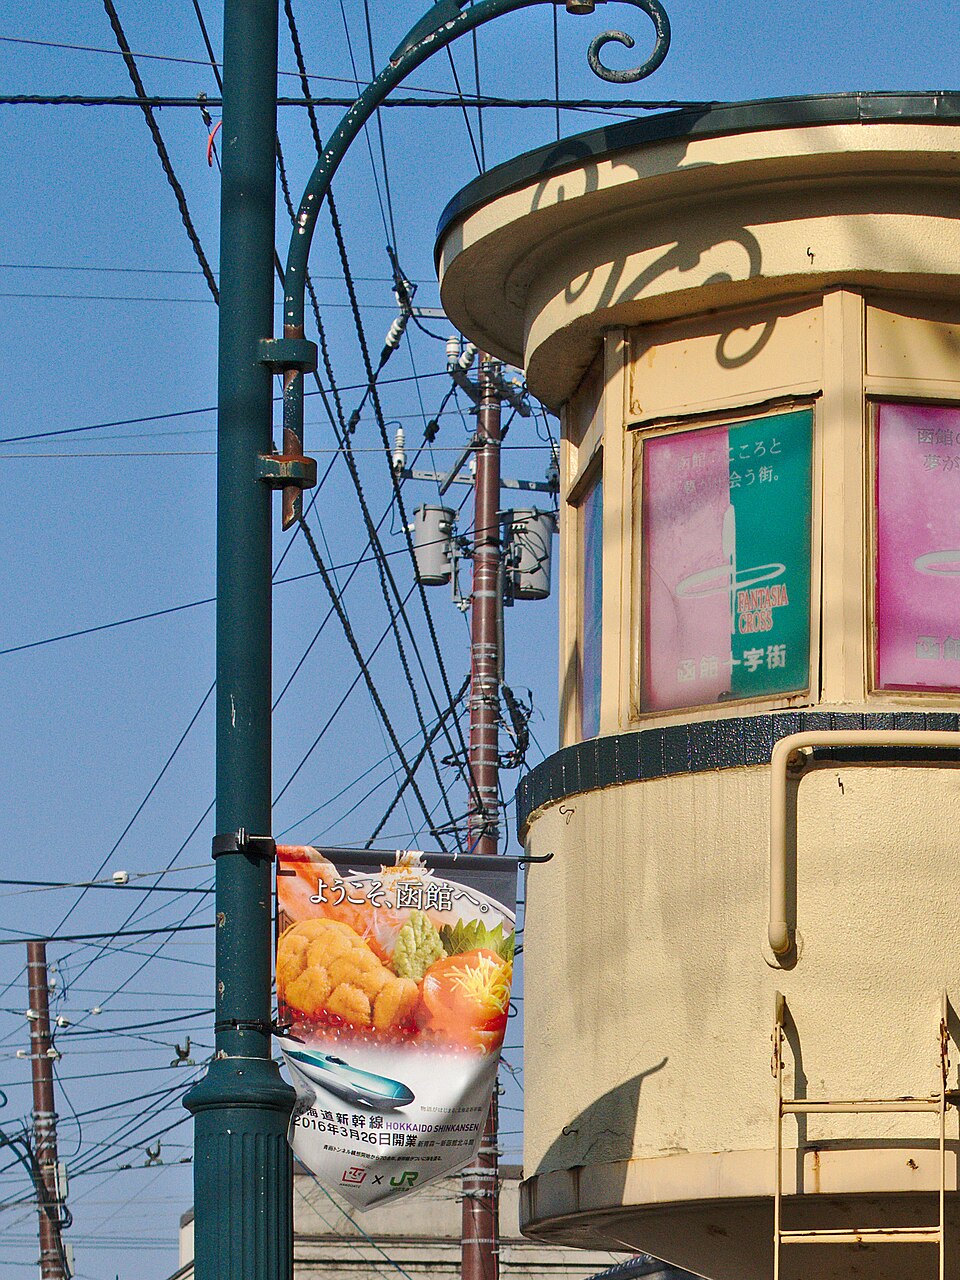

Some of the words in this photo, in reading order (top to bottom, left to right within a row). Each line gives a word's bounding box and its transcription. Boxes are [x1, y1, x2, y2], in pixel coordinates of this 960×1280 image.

[737, 583, 789, 613] FANTASIA
[738, 609, 773, 634] CROSS
[308, 876, 491, 915] ようこそ、函館へ。
[292, 1114, 418, 1148] 2016年3月26日開業
[386, 1122, 433, 1133] HOKKAIDO
[433, 1123, 479, 1133] SHINKANSEN
[390, 1171, 419, 1187] JR
